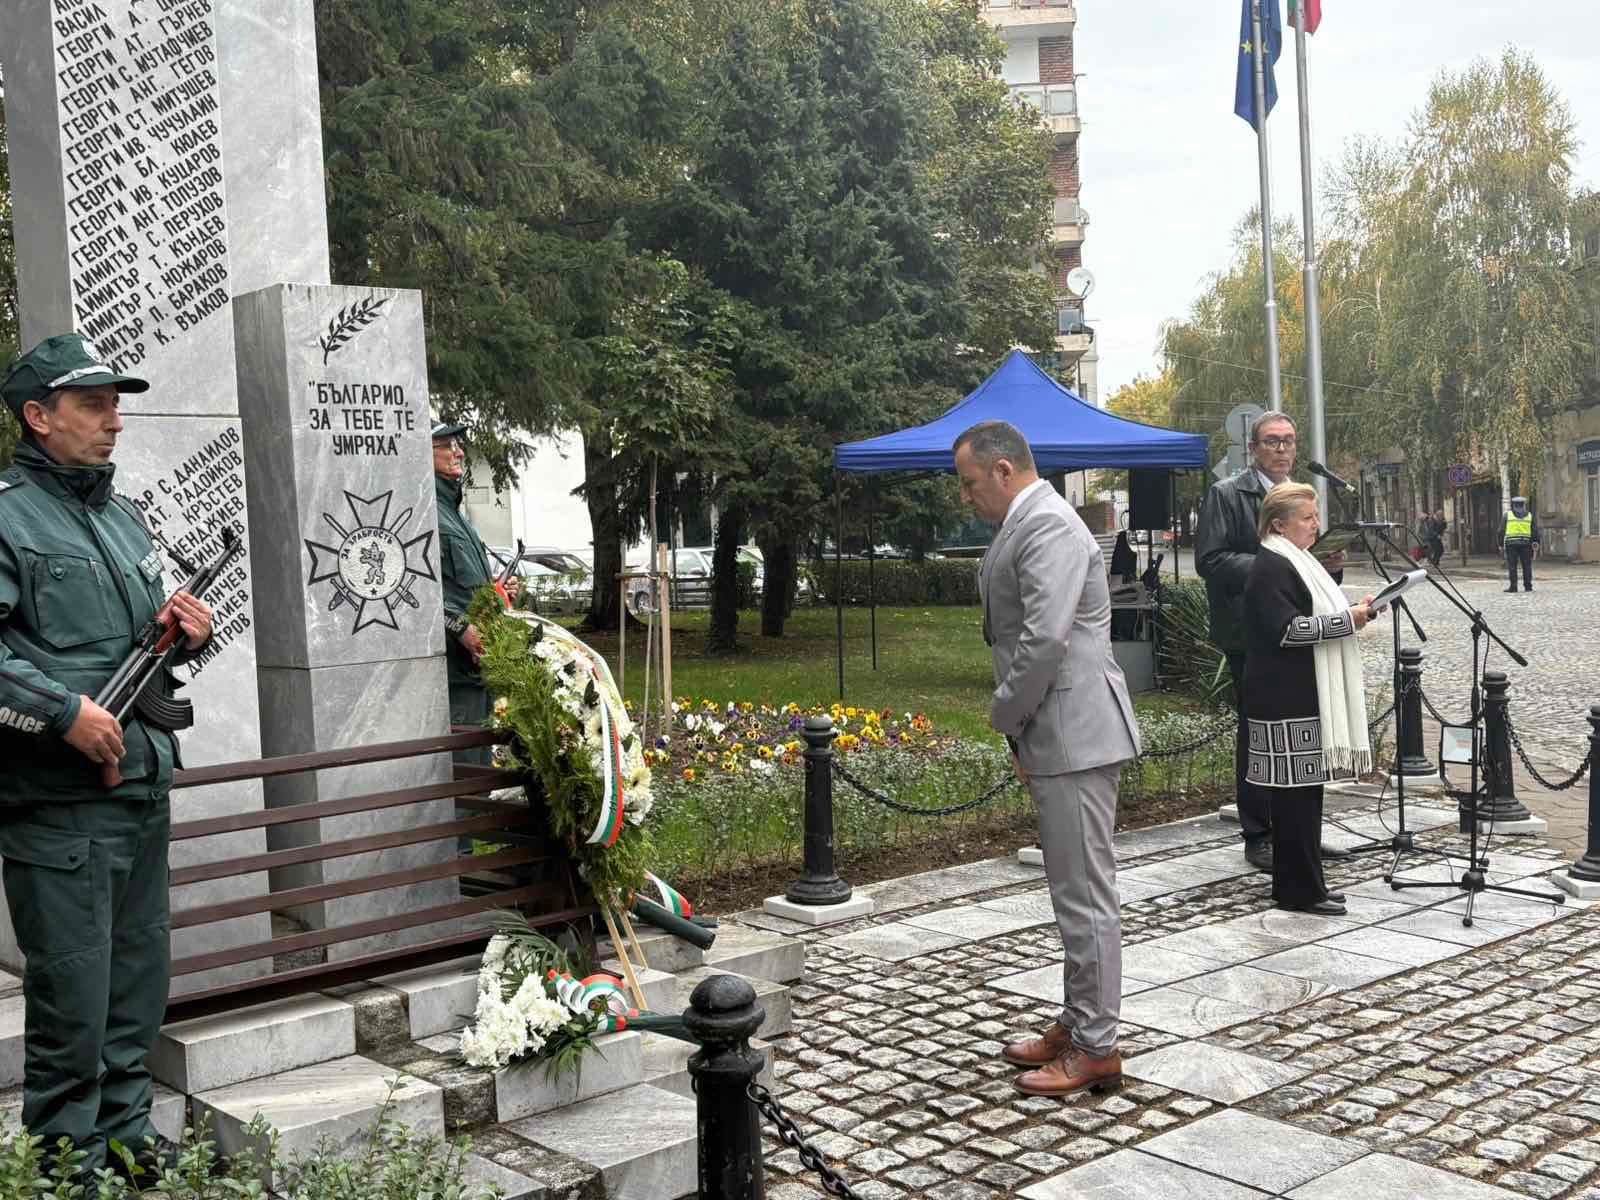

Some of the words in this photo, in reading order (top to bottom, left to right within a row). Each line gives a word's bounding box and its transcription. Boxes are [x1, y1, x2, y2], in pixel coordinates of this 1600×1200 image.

[54, 3, 107, 38] ВАСИЛ
[56, 22, 116, 63] ГЕОРГИ
[128, 10, 148, 28] А.
[58, 48, 117, 89] ГЕОРГИ
[124, 32, 151, 55] АТ.
[158, 0, 212, 36] ГЪРНЕВ
[61, 73, 120, 115] ГЕОРГИ
[118, 65, 138, 83] С.
[134, 20, 214, 74] МУТАФЧИЕВ
[62, 98, 121, 140] ГЕОРГИ
[129, 75, 165, 104] АНГ.
[169, 44, 215, 79] ГЕГОВ
[66, 122, 125, 165] ГЕОРГИ
[125, 108, 153, 131] СТ.
[151, 69, 217, 116] МИТУШЕВ
[66, 148, 125, 191] ГЕОРГИ
[122, 136, 151, 159] ИВ.
[67, 173, 127, 218] ГЕОРГИ
[134, 156, 165, 178] БЛ.
[170, 119, 218, 156] КЮЛЕВ
[70, 198, 128, 242] ГЕОРГИ
[129, 184, 158, 206] ИВ.
[157, 143, 220, 190] КУЦАРОВ
[71, 224, 129, 268] ГЕОРГИ
[132, 203, 164, 232] АНГ.
[160, 166, 222, 212] ТОПУЗОВ
[72, 242, 139, 299] ДИМИТЪР
[145, 231, 166, 248] С.
[163, 191, 223, 237] ПЕРУХОВ
[74, 267, 140, 324] ДИМИТЪР
[148, 254, 168, 270] Т.
[168, 215, 226, 260] КЪНДЕВ
[144, 282, 163, 300] Г.
[160, 238, 227, 290] НОЖАРОВ
[94, 317, 144, 360] МИТЪР
[148, 305, 169, 323] П.
[168, 262, 228, 310] БАРАКОВ
[153, 328, 175, 346] К.
[174, 287, 229, 332] ВЪЛКОВ
[309, 408, 331, 430] ЗА
[341, 408, 384, 430] ТЕБЕ
[393, 409, 415, 431] ТЕ
[332, 433, 402, 456] УМРЯХА"
[148, 505, 171, 529] АТ.
[173, 450, 242, 508] РАДОЙКОВ
[158, 479, 176, 495] С.
[174, 426, 240, 486] ДАНАИЛОВ
[182, 473, 243, 525] КРЪСТЕВ
[0, 706, 46, 735] OLICE
